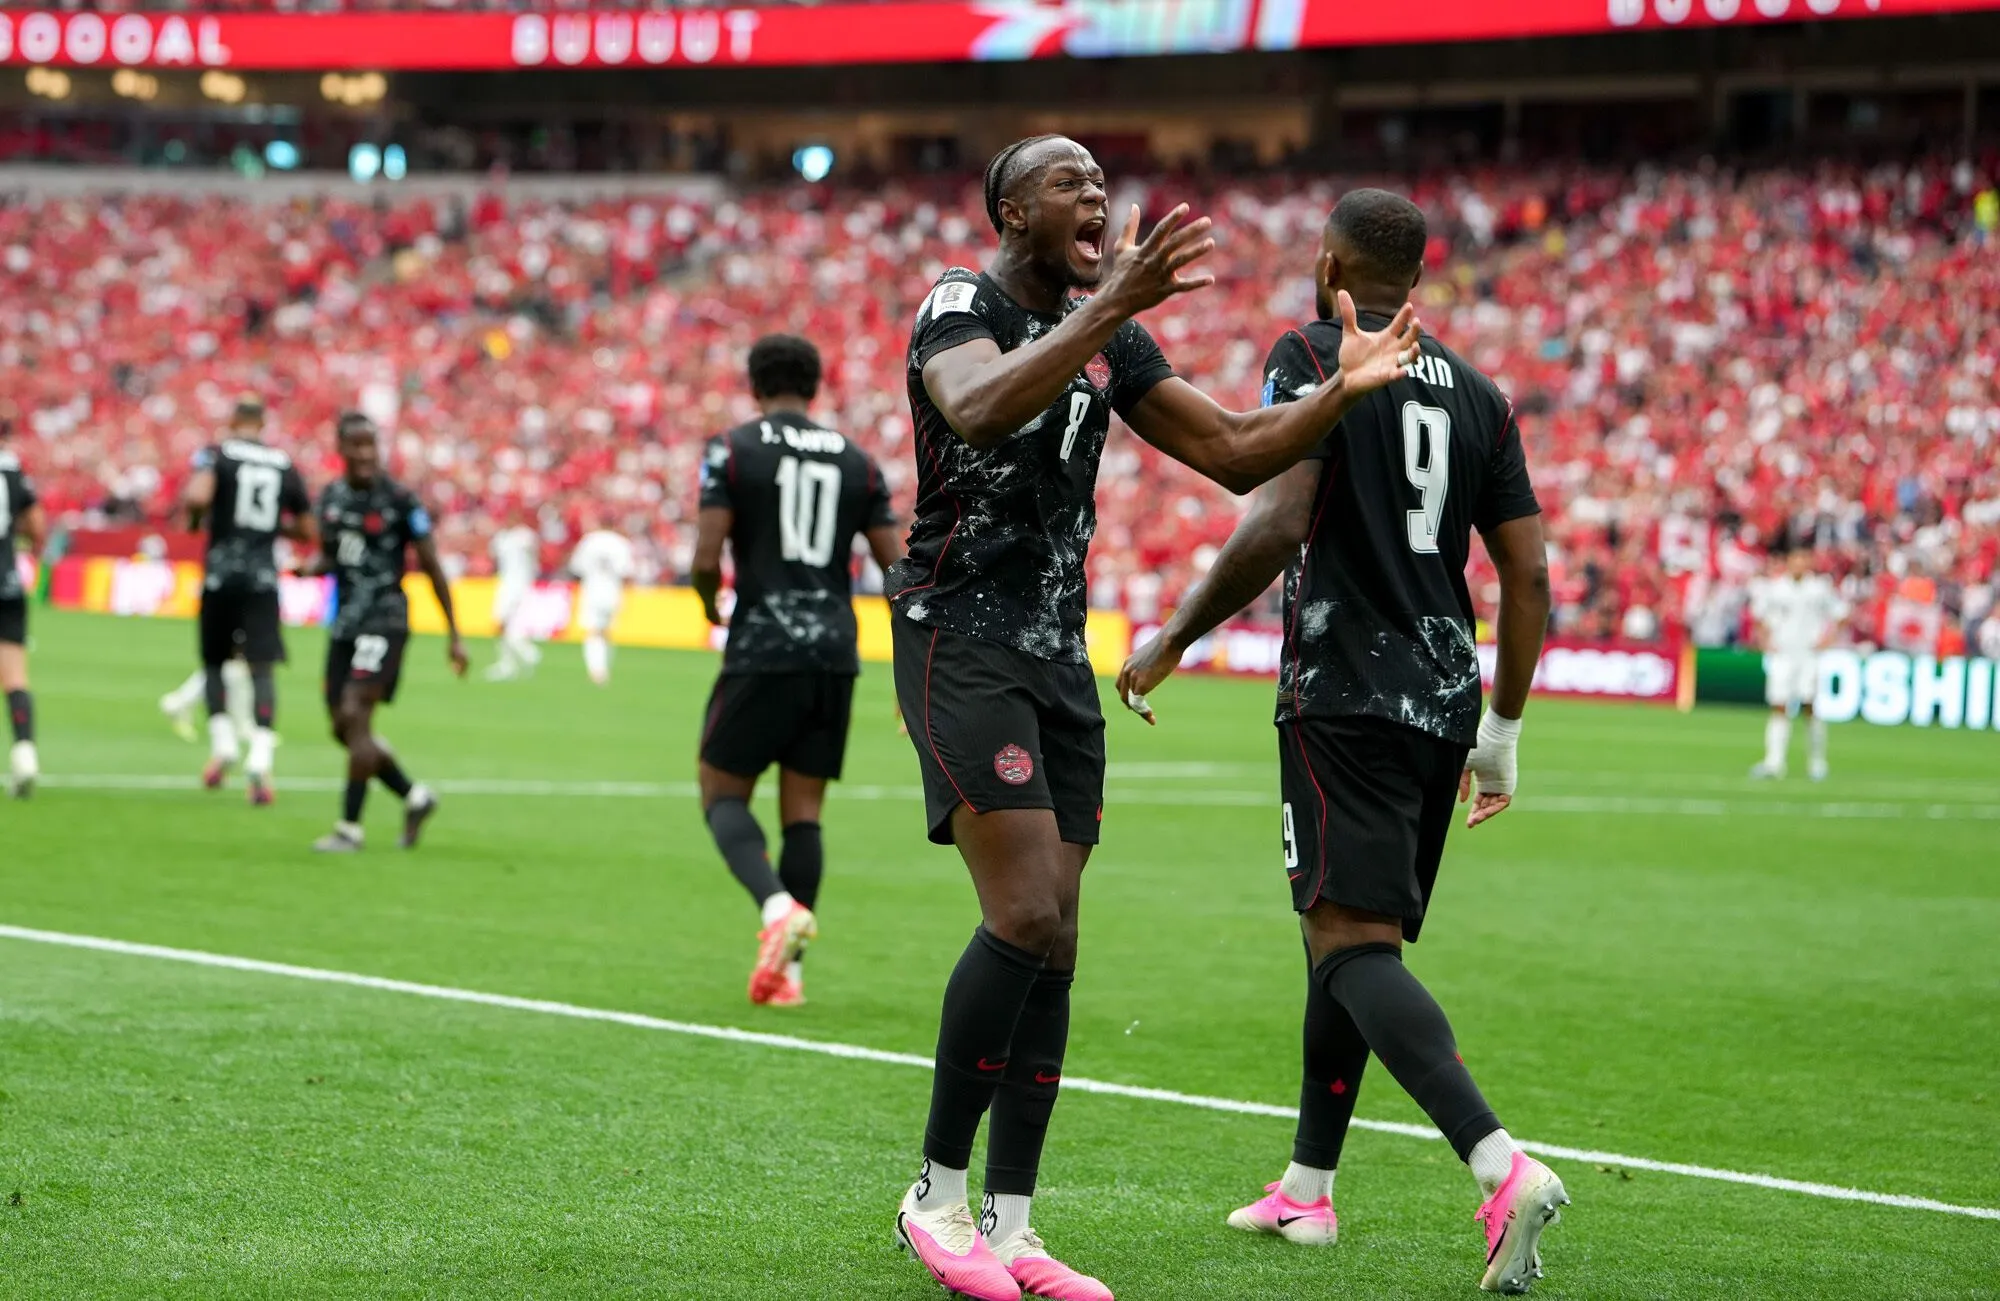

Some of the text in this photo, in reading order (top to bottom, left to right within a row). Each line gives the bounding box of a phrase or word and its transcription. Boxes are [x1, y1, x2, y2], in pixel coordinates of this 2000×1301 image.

[1060, 391, 1092, 461] 8
[234, 463, 283, 533] 13
[774, 455, 843, 569] 10
[1402, 399, 1451, 554] 9
[1763, 648, 2000, 731] OSHI
[1283, 802, 1299, 869] 9
